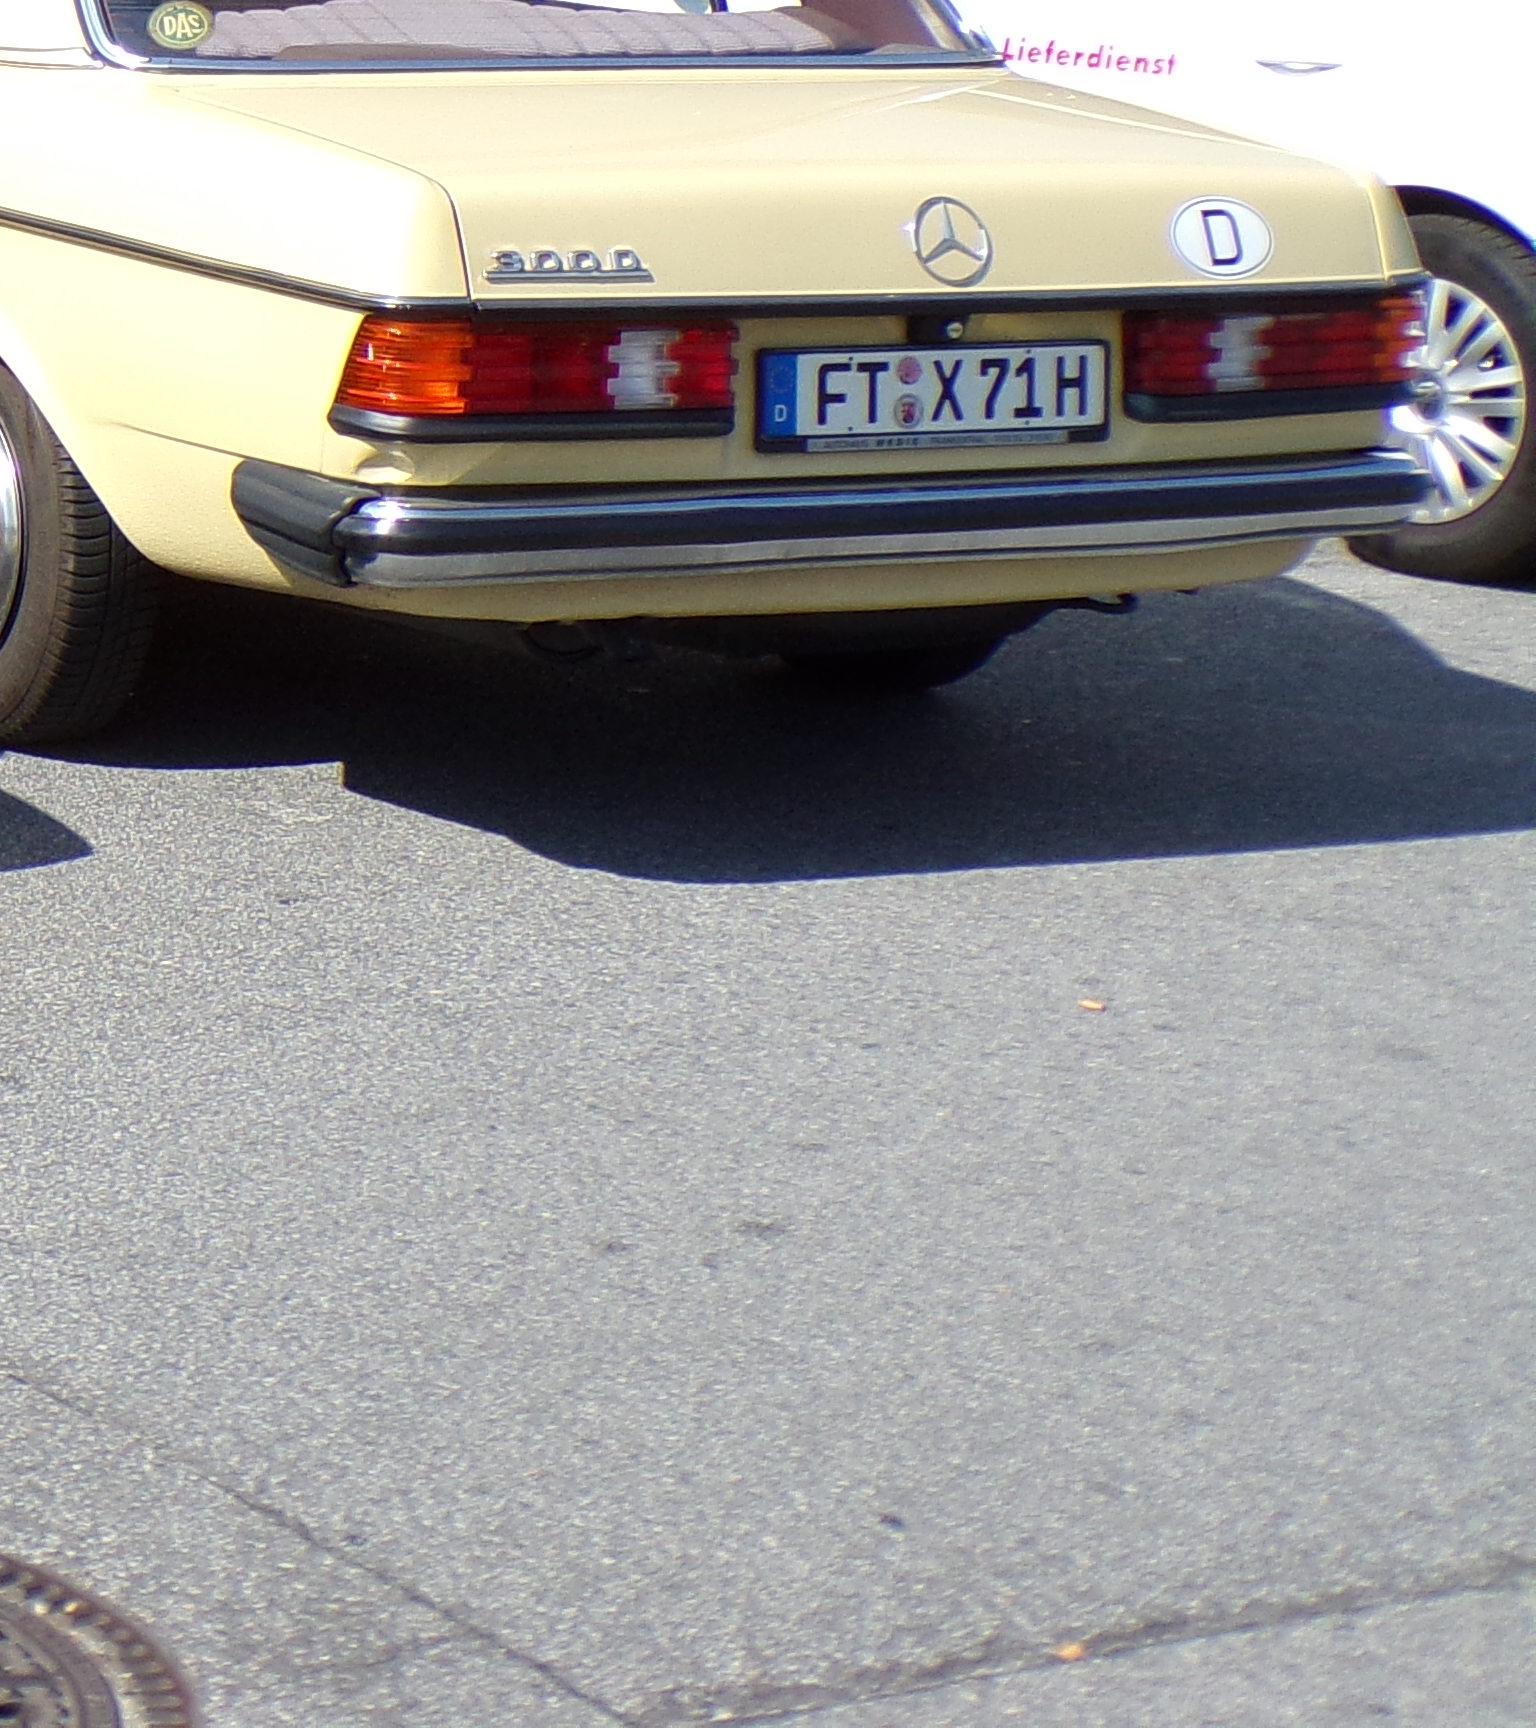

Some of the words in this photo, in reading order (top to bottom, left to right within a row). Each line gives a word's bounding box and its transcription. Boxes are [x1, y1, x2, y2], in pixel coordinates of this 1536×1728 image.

[1002, 37, 1176, 75] Lieferdienst
[1199, 208, 1243, 266] D
[774, 405, 787, 422] D
[817, 361, 890, 426] FT
